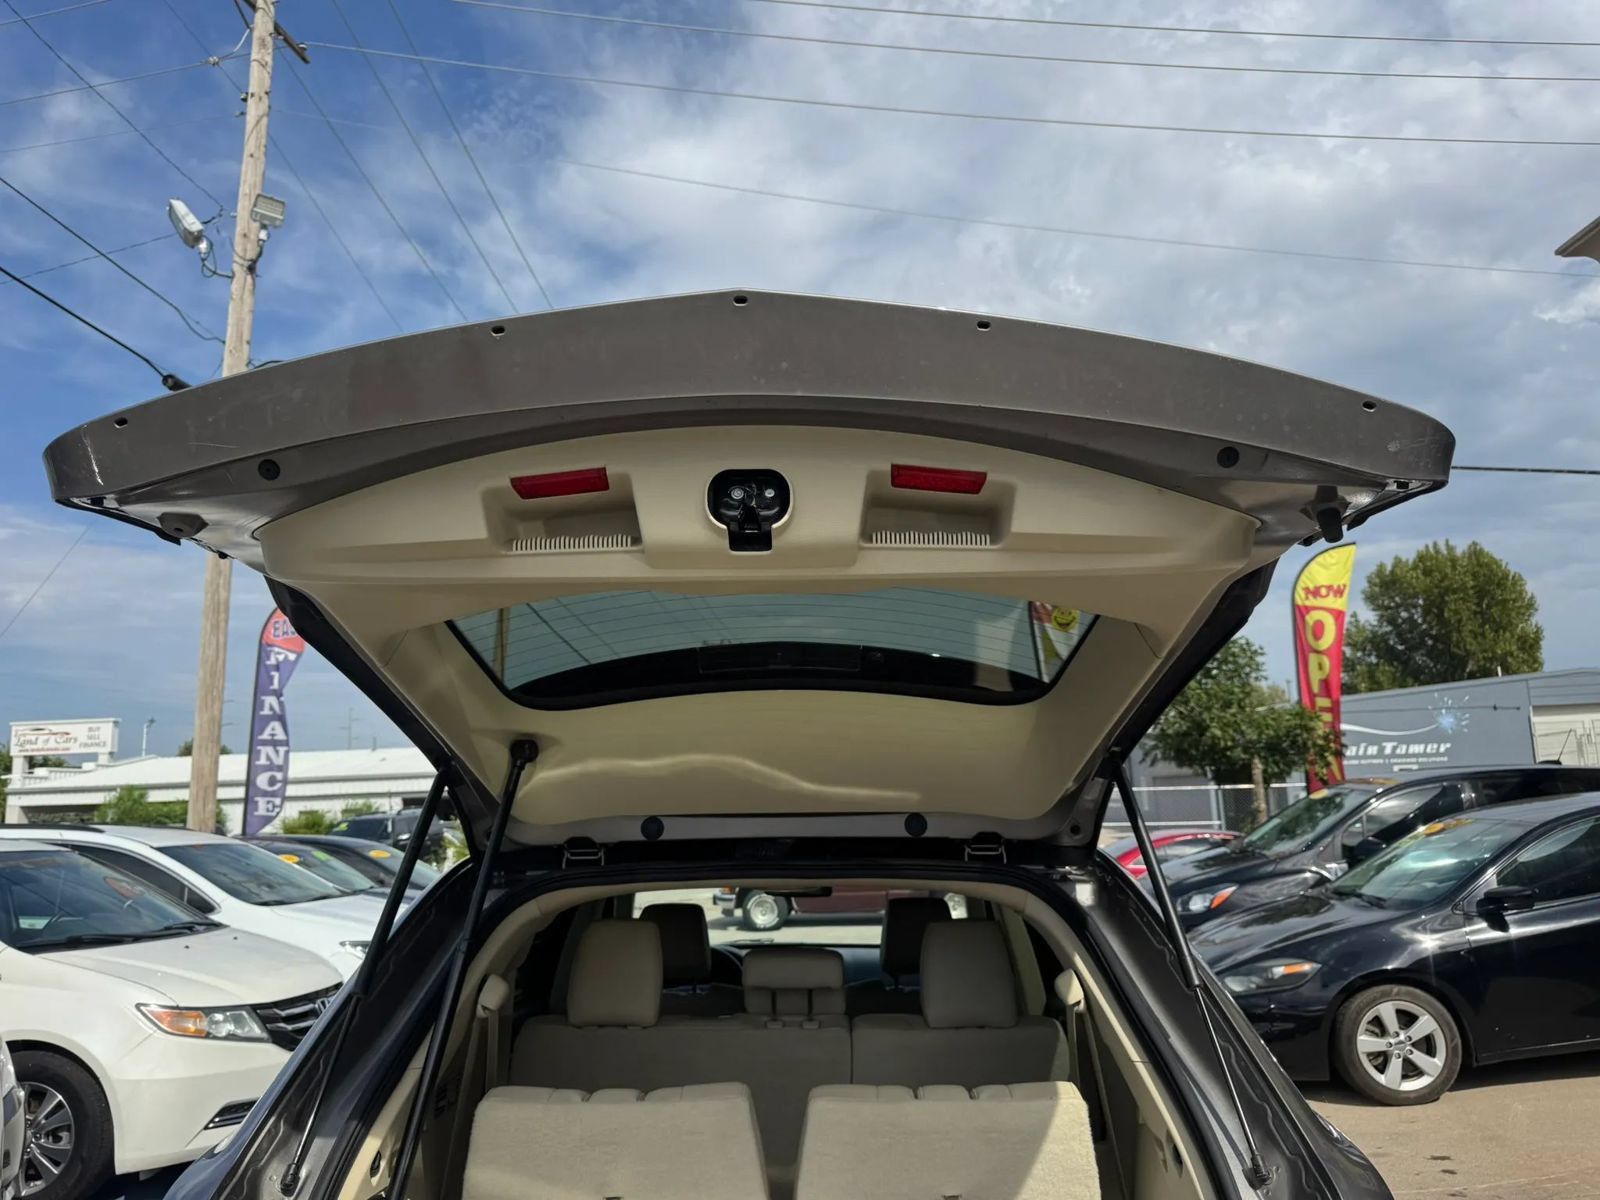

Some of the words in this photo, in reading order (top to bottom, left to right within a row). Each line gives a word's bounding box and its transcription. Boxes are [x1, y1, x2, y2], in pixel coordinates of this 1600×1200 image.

[1302, 584, 1347, 600] NOW
[253, 646, 298, 817] FINANCE
[14, 736, 39, 747] Land
[54, 735, 79, 745] Cars
[1382, 741, 1452, 755] Tamer
